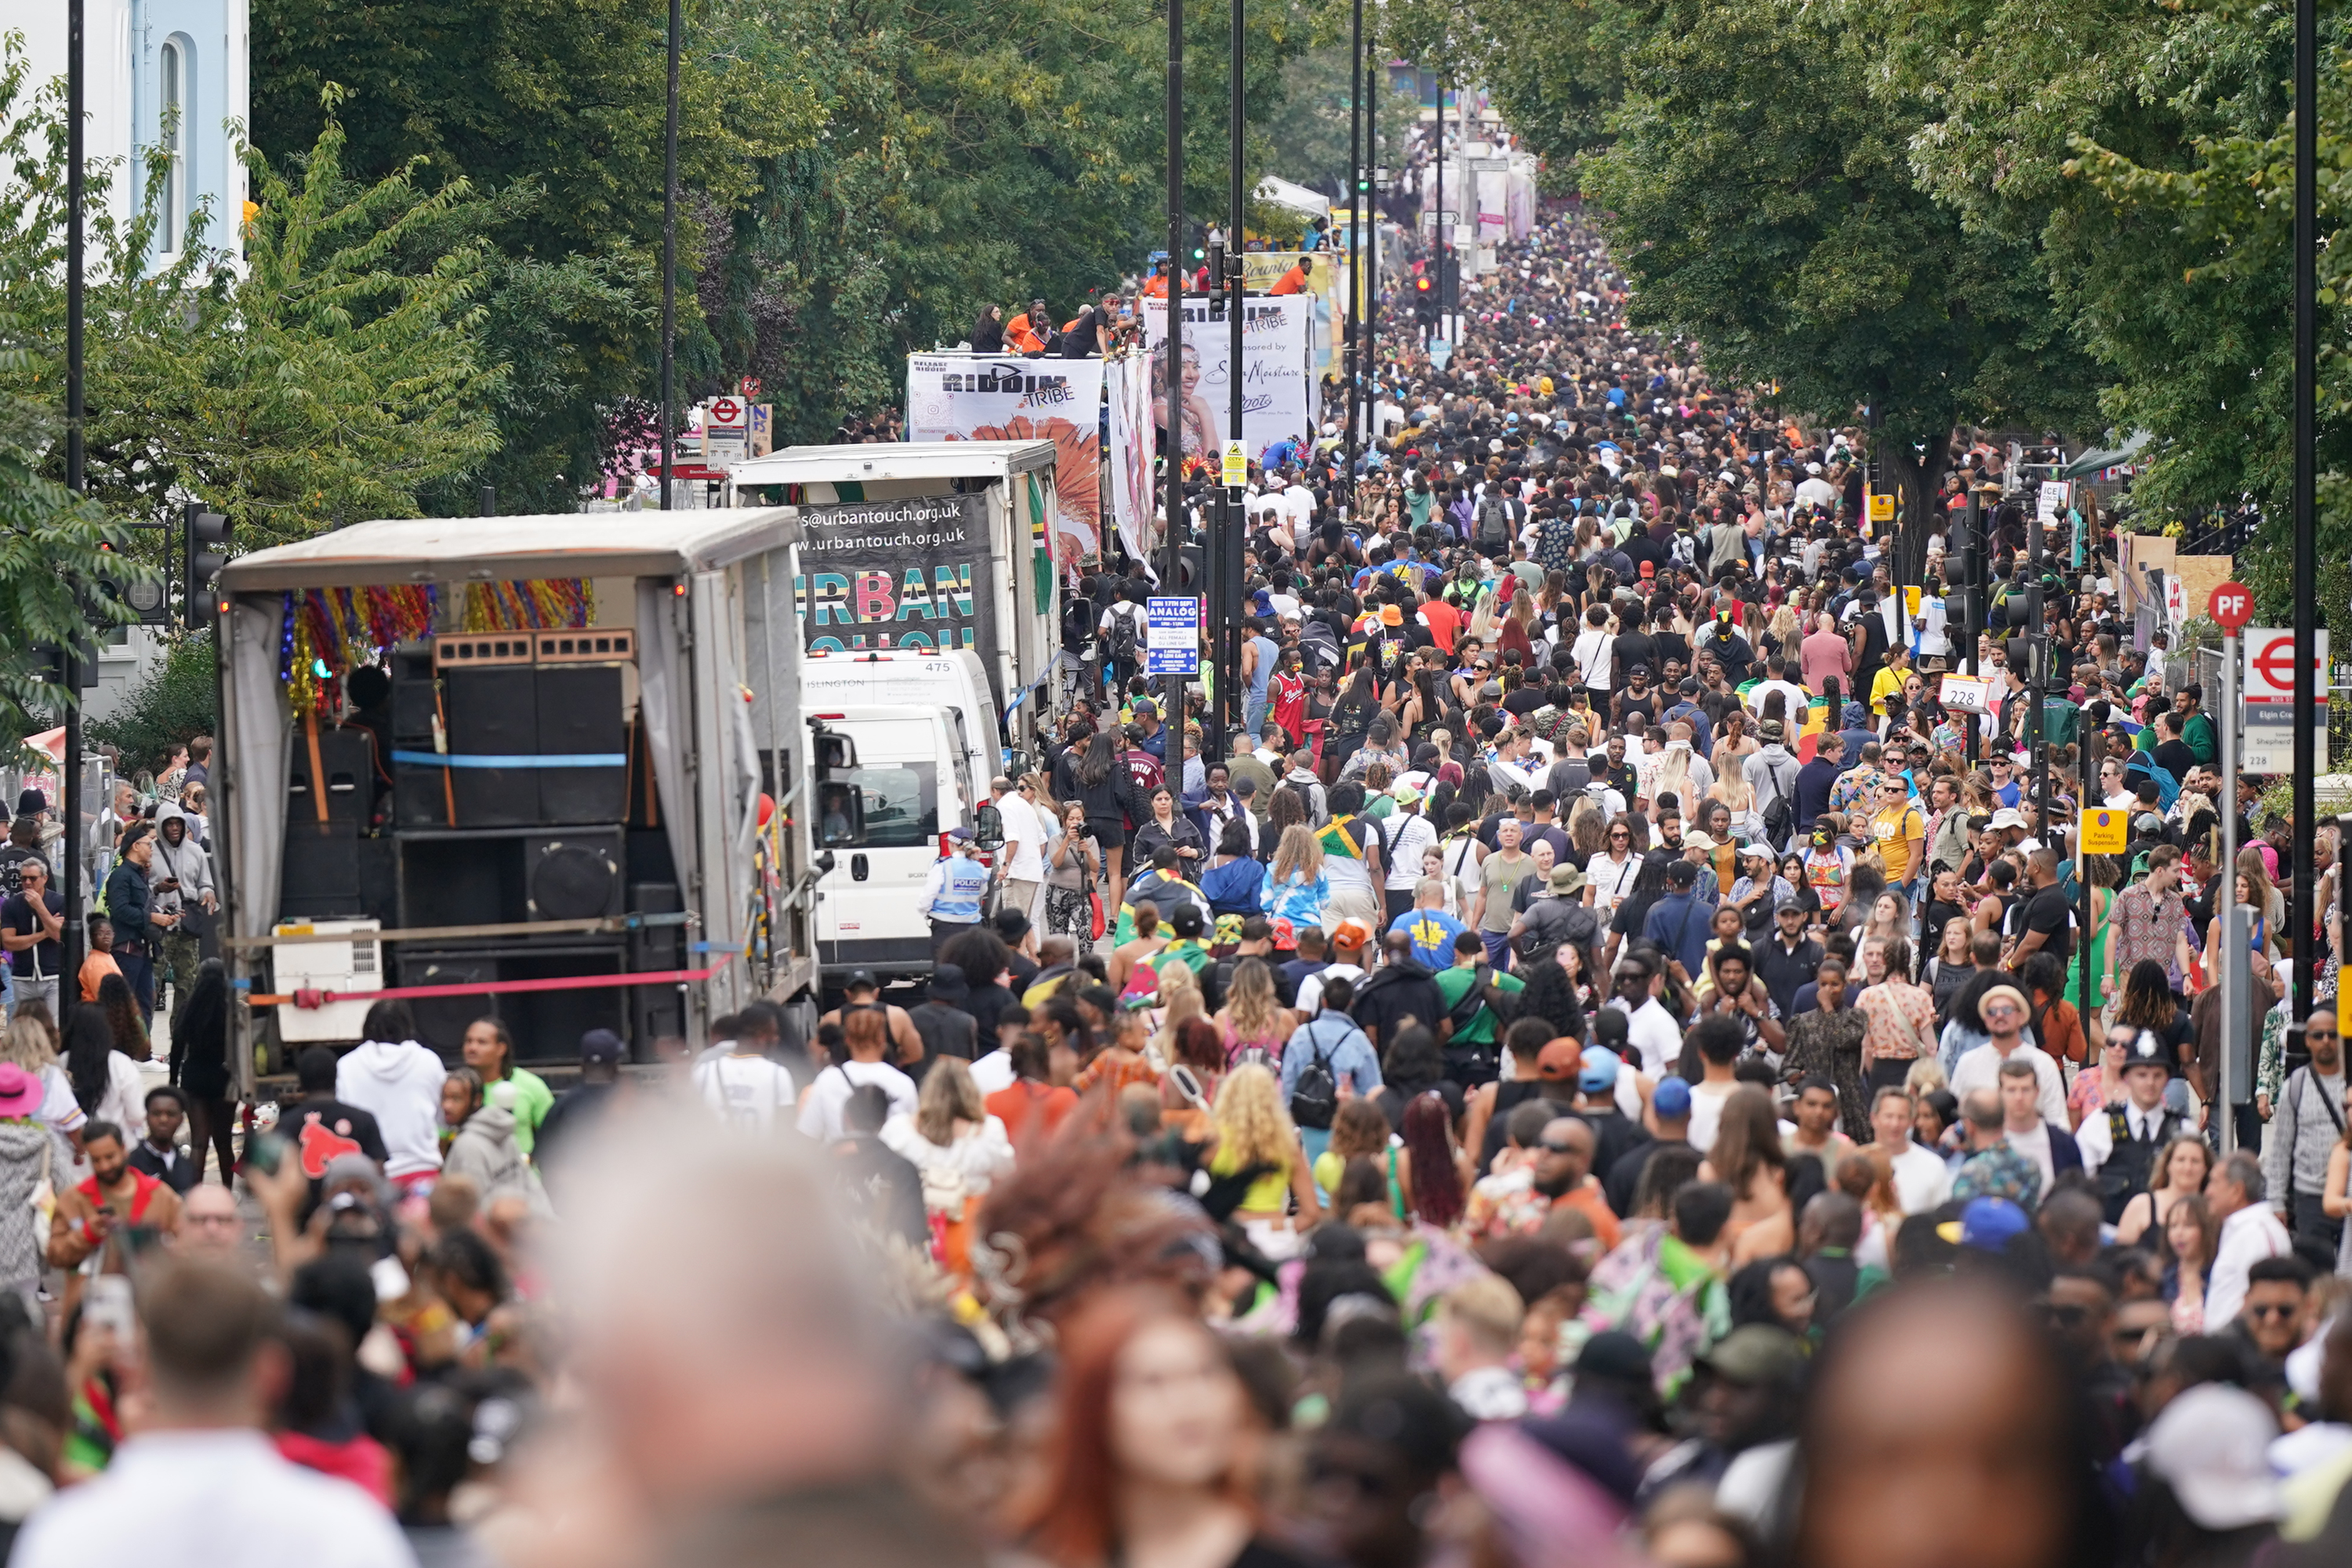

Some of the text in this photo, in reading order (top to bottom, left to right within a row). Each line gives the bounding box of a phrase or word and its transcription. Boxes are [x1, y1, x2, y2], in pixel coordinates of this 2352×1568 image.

[1243, 259, 1294, 279] Bounty
[1247, 314, 1289, 333] TRIBE
[1275, 343, 1287, 352] by
[1205, 360, 1300, 385] Sa Moisture
[942, 373, 1067, 393] RIDDIM
[1022, 386, 1076, 408] TRIBE
[2043, 487, 2058, 495] ICE
[797, 503, 961, 528] s@urbantouch.org.uk
[1149, 607, 1196, 616] ANALOG
[2217, 596, 2245, 616] PF
[925, 662, 950, 672] 475
[807, 680, 865, 688] ISLINGTON
[1950, 690, 1975, 706] 228
[2259, 710, 2295, 720] Elgin Cre
[2249, 757, 2267, 765] 228
[1320, 841, 1341, 850] AMAICA
